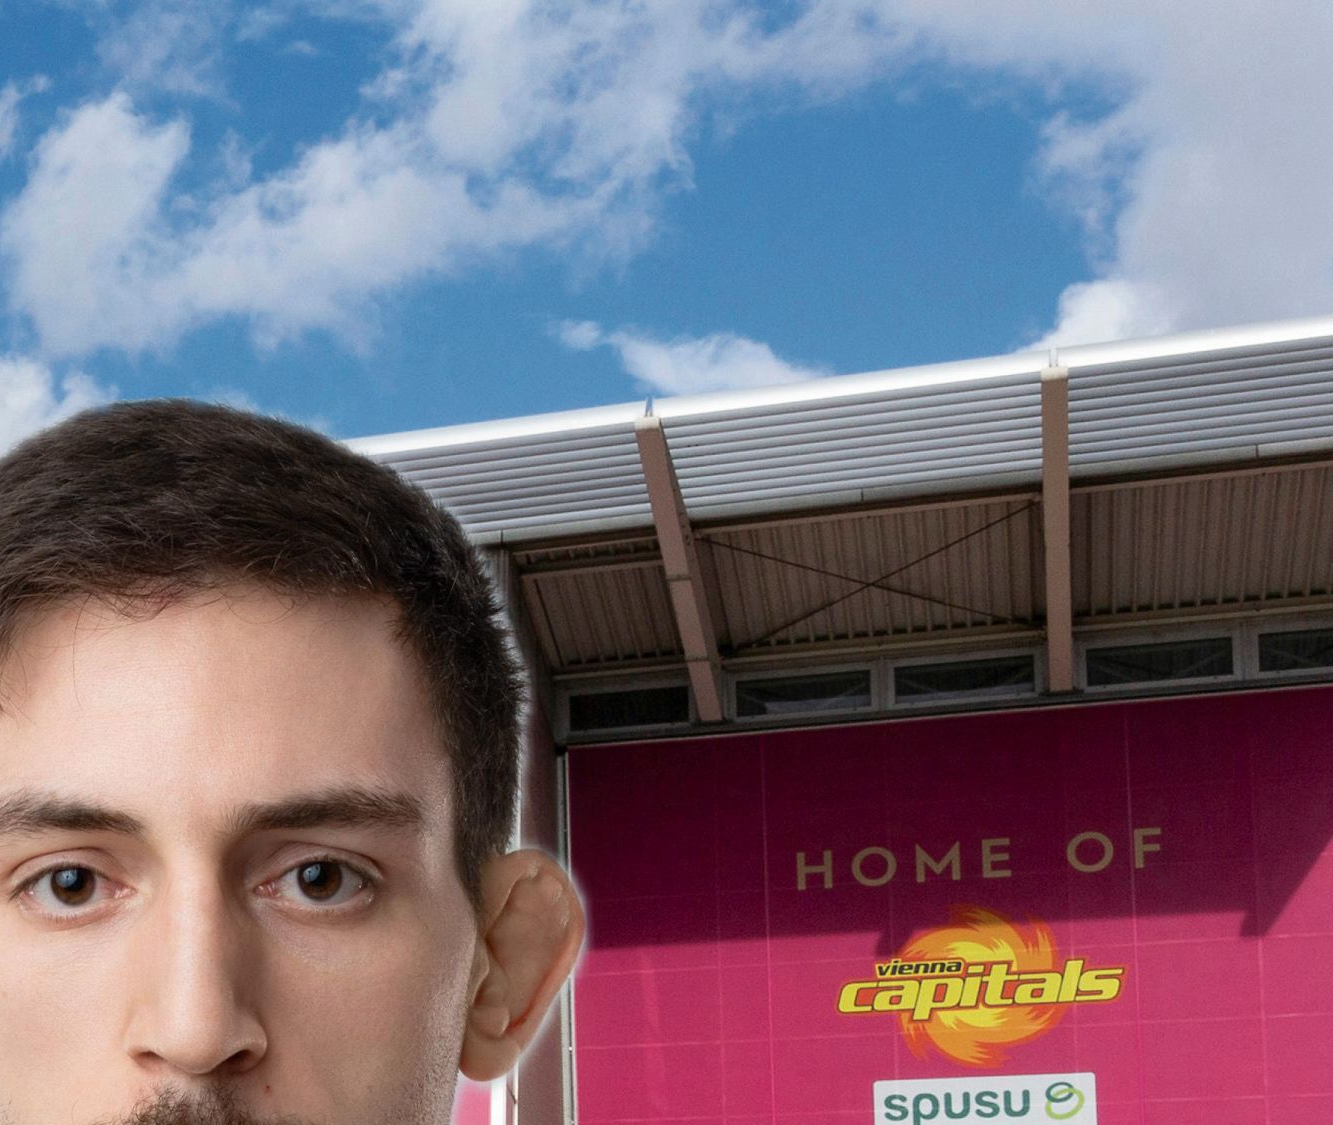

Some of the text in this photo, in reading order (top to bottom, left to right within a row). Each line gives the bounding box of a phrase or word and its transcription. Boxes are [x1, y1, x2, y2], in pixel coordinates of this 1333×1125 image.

[796, 827, 1162, 891] HOME OF
[837, 958, 1125, 1021] capitals
[877, 960, 962, 977] vienna
